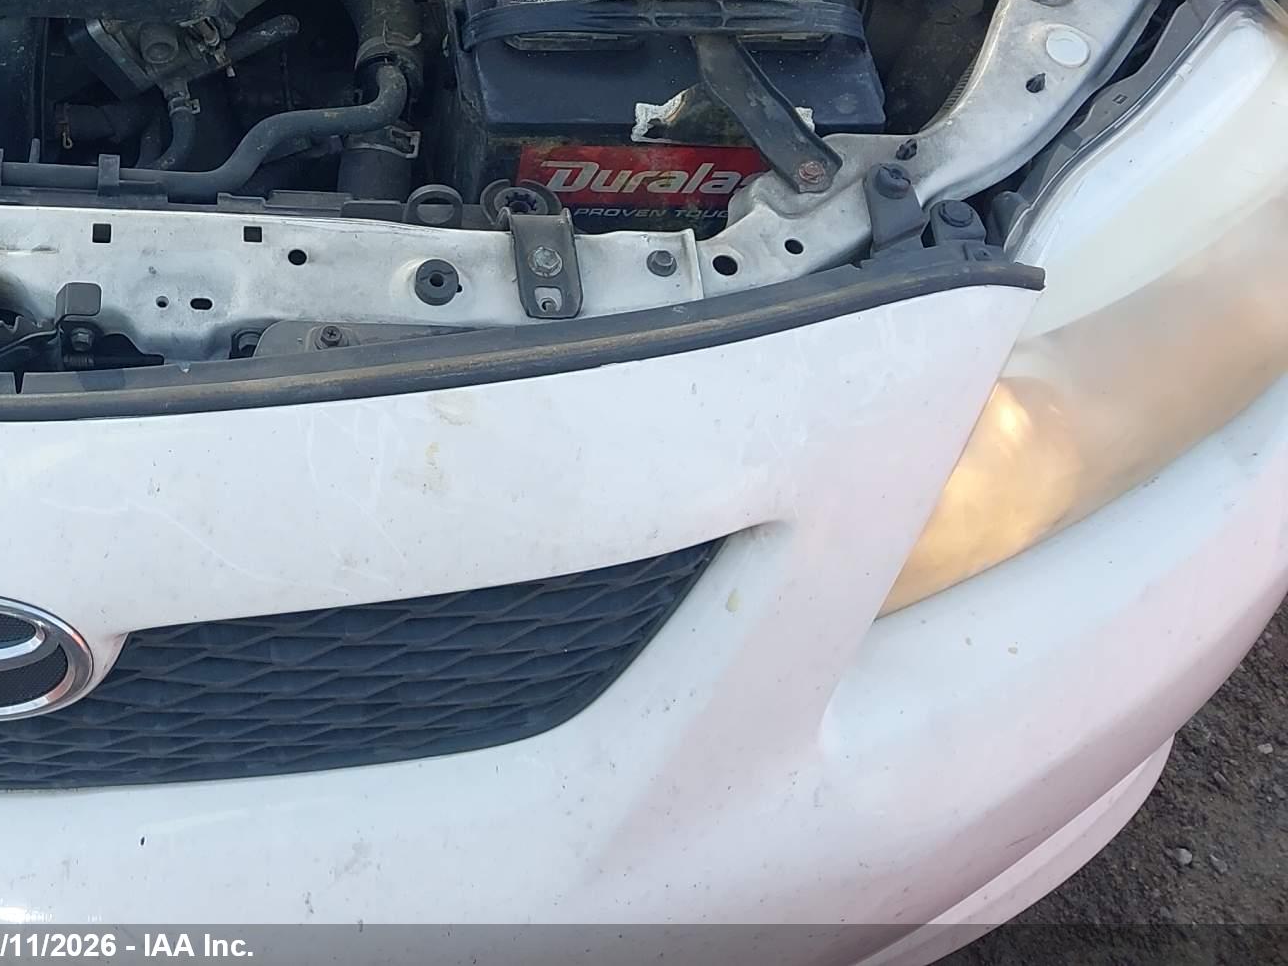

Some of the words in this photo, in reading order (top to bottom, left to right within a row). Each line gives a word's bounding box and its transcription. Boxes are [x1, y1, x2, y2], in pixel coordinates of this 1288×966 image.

[540, 161, 764, 195] Durala
[573, 208, 666, 218] PROVEN
[675, 209, 729, 218] TOUG
